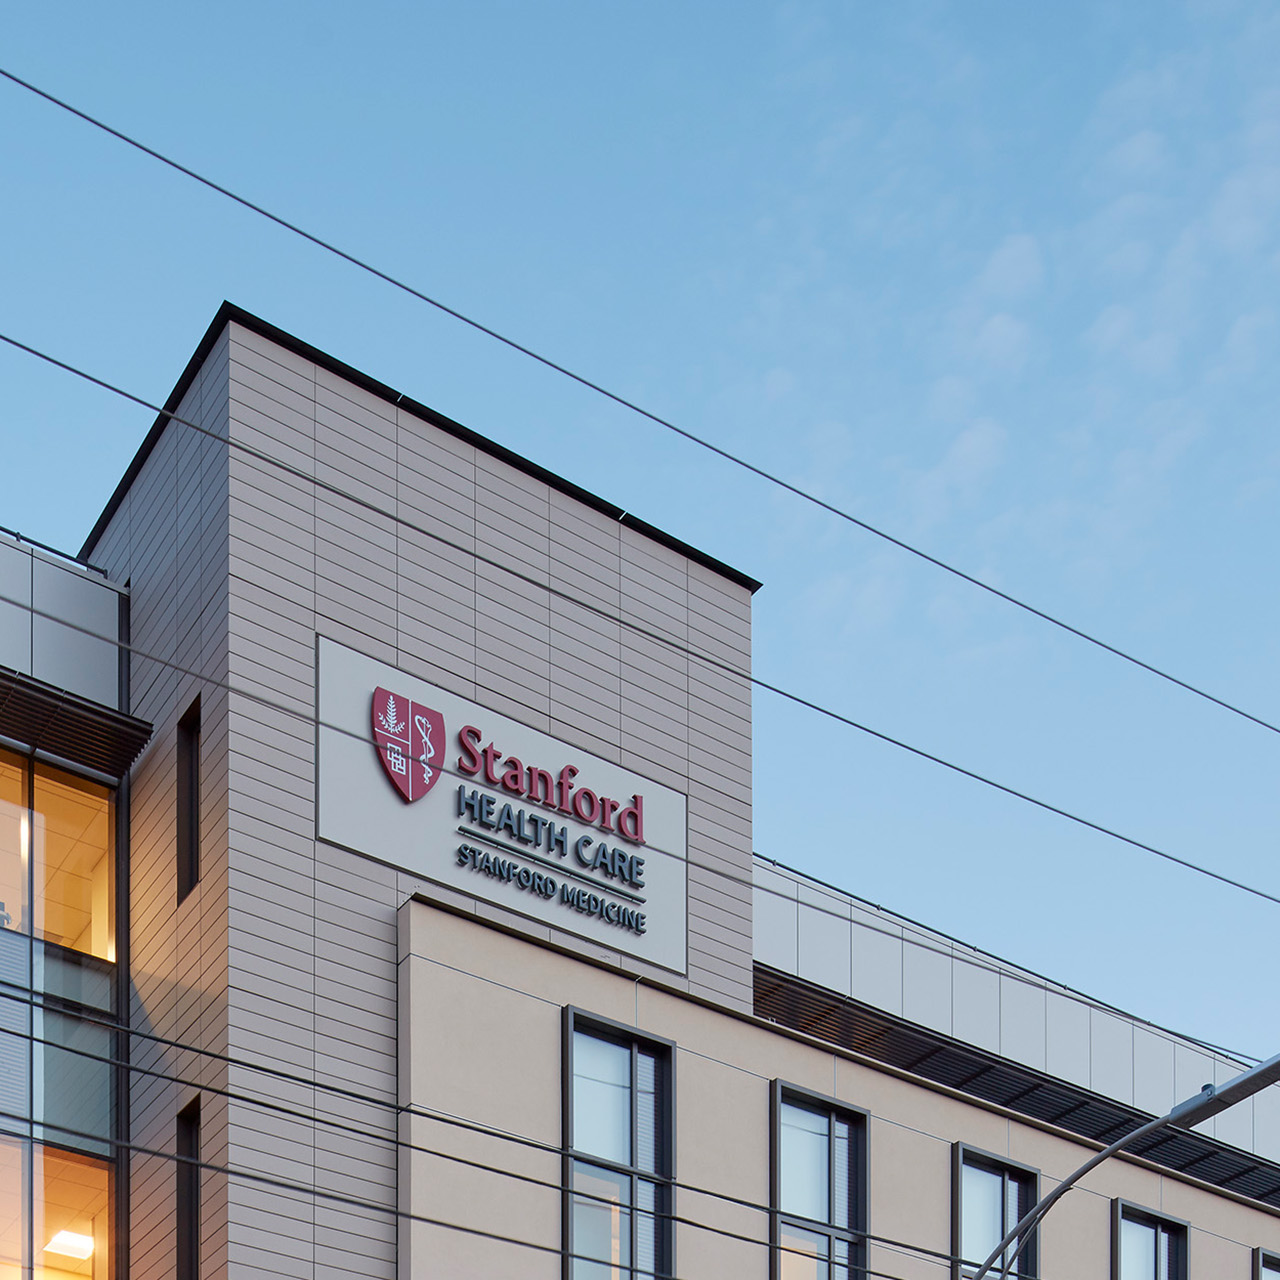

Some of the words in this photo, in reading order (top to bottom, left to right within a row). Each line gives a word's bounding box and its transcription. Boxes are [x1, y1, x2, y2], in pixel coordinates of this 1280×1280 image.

[457, 724, 646, 844] Stanford
[458, 785, 569, 857] HEALTH
[577, 835, 646, 889] CARE
[457, 843, 557, 901] STANFORD
[561, 883, 647, 936] MEDICINE
